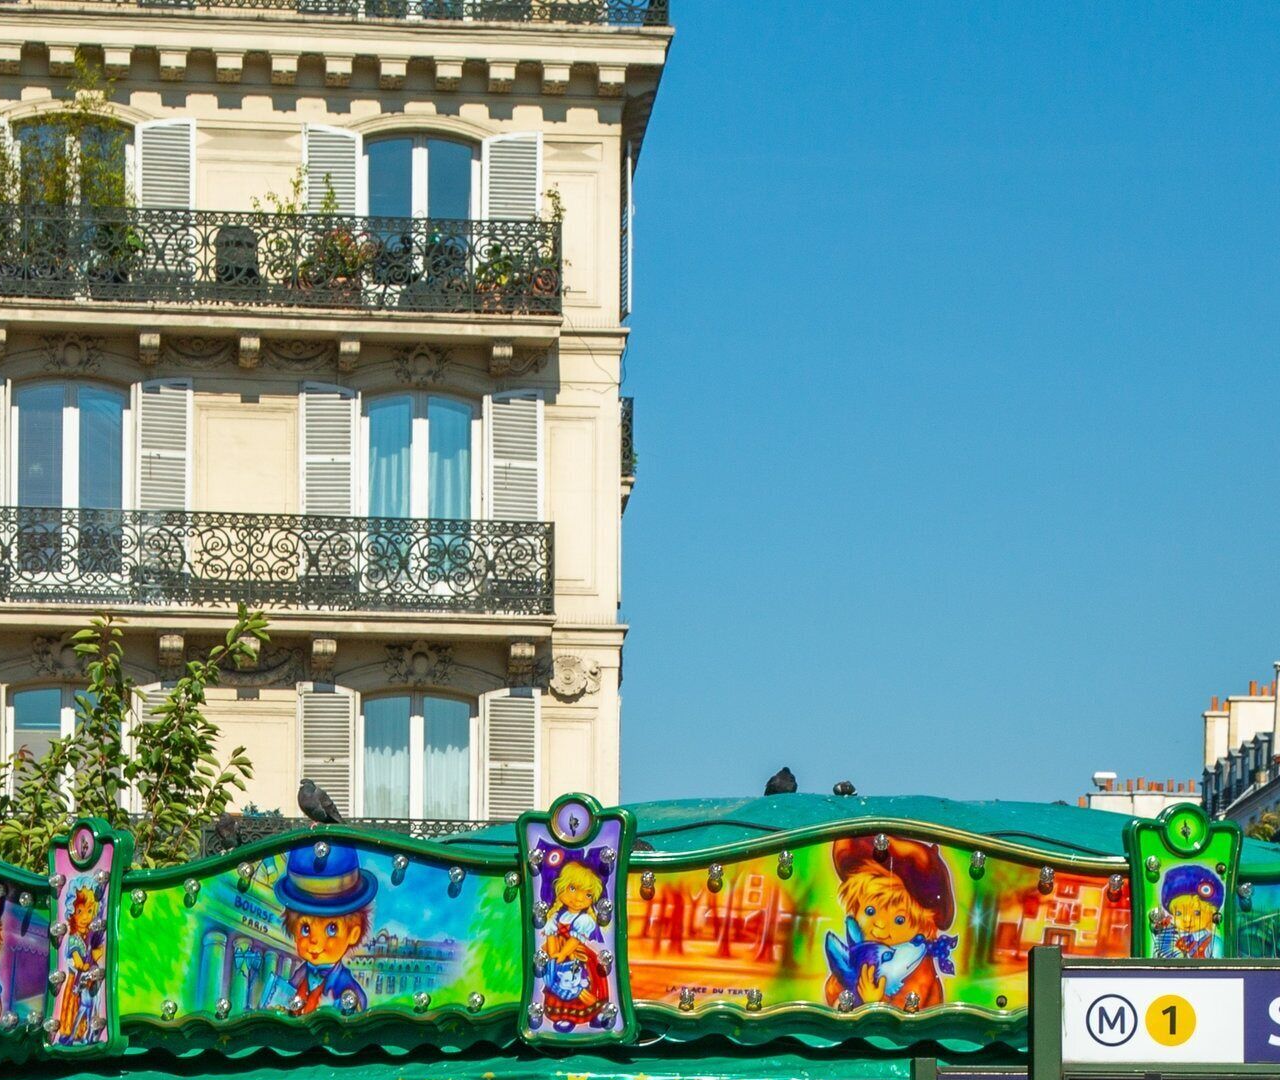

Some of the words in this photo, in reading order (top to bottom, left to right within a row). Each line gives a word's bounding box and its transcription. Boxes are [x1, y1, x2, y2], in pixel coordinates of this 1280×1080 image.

[234, 895, 275, 923] BOURSE
[242, 915, 269, 934] PARIS
[681, 986, 707, 994] PACE
[1098, 1005, 1126, 1035] M
[1161, 1005, 1177, 1035] 1
